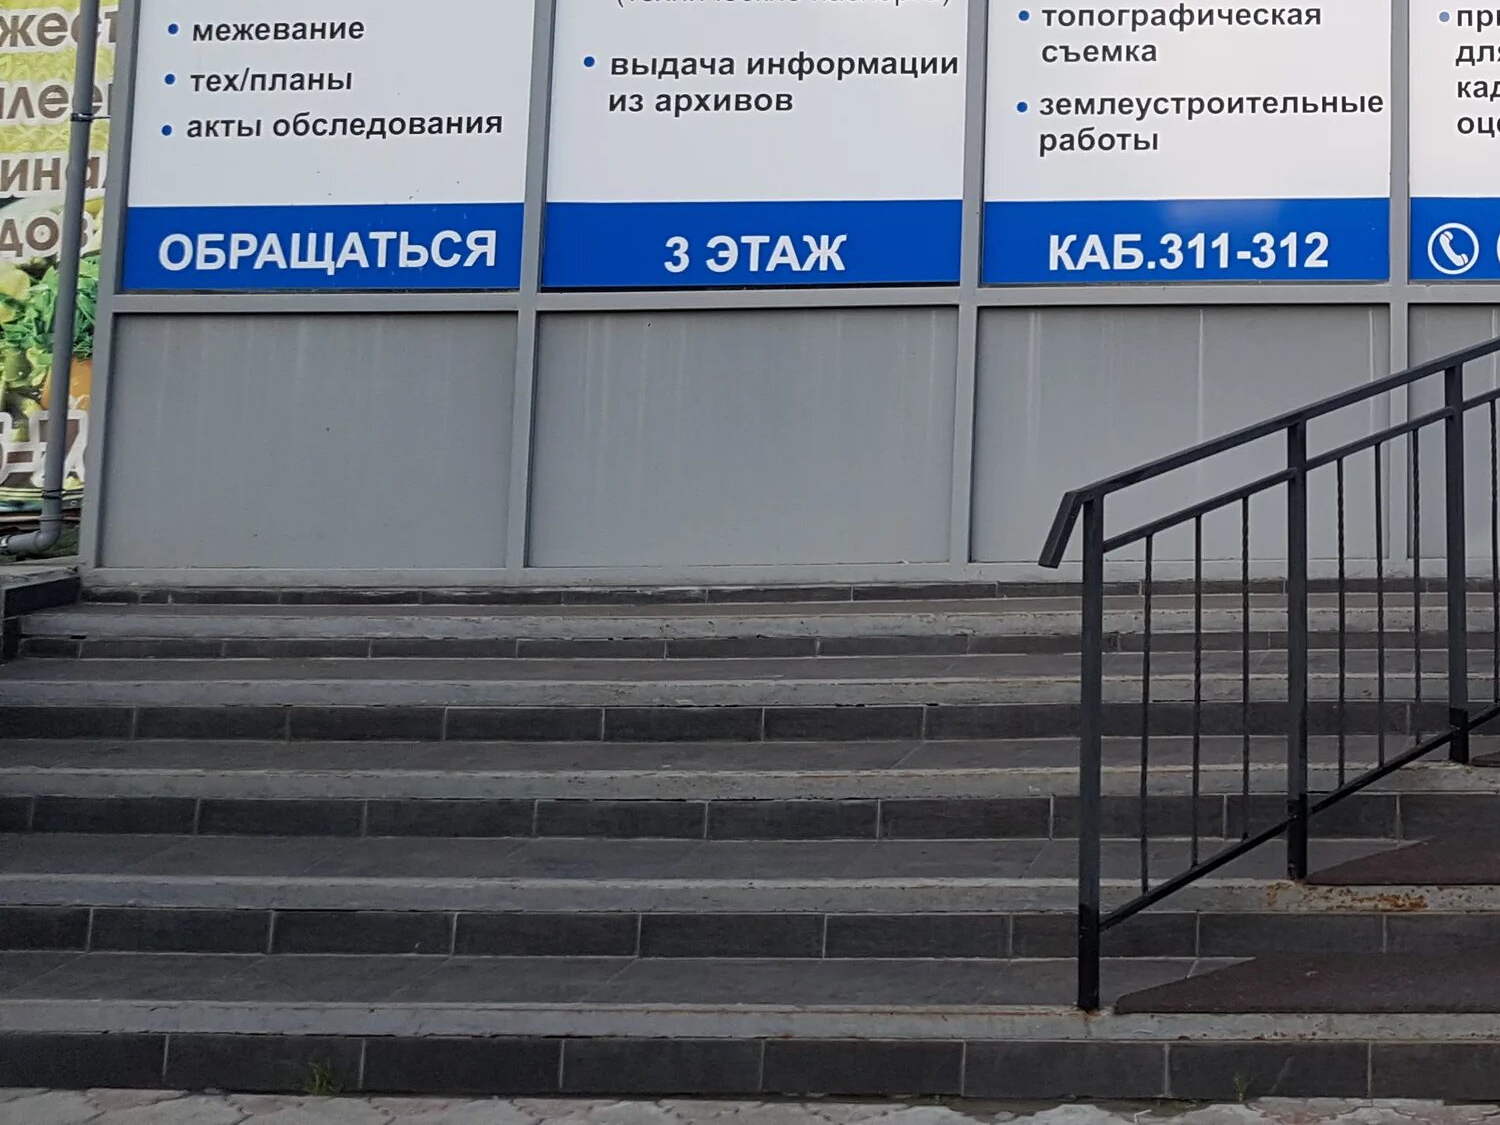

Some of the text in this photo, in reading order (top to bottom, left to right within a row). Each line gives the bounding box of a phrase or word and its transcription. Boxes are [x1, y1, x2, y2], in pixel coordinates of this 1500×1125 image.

[192, 20, 365, 42] межевание
[1042, 2, 1322, 32] топографическая
[610, 52, 959, 81] выдача информации
[1041, 43, 1158, 63] съемка
[190, 68, 353, 92] тех/планы
[608, 92, 793, 117] из архивов
[1039, 93, 1384, 121] землеустроительные
[187, 113, 502, 140] акты обследования
[1039, 127, 1158, 157] работы
[158, 229, 497, 276] ОБРАЩАТЬСЯ
[663, 233, 848, 273] 3 ЭТАЖ
[1048, 232, 1329, 271] КАБ.311-312
